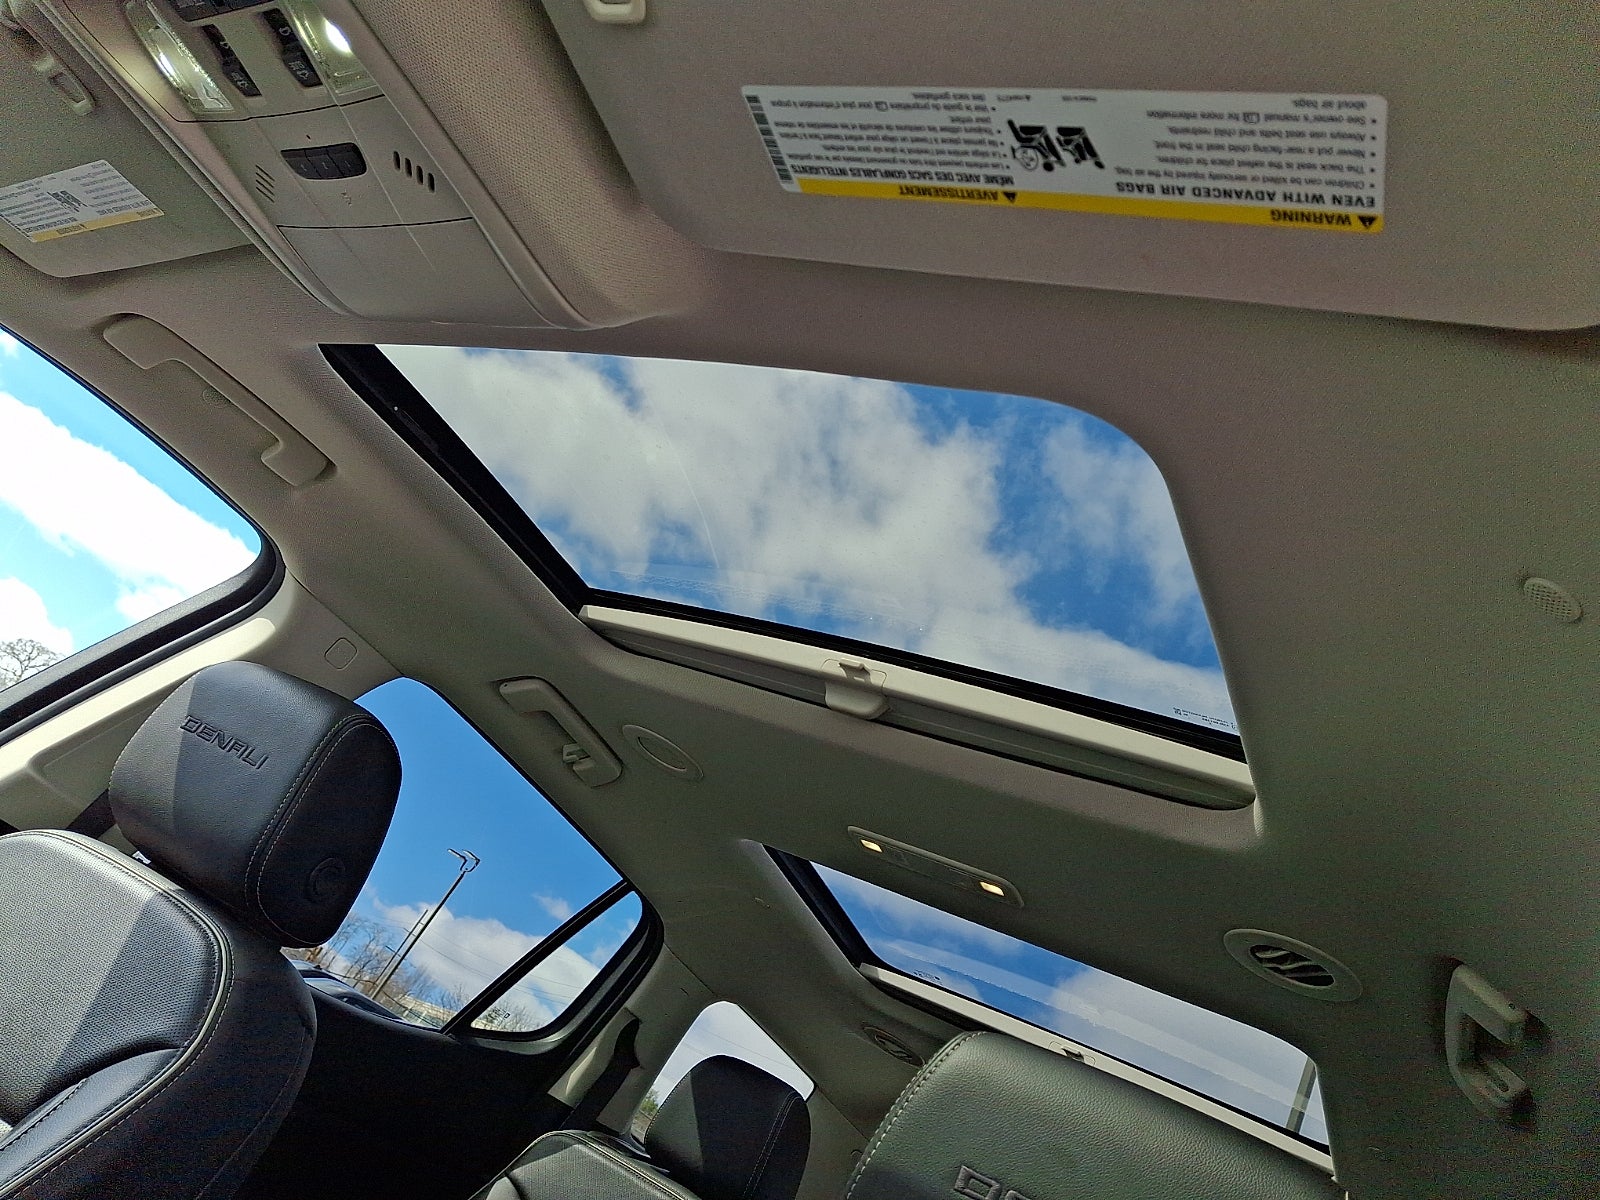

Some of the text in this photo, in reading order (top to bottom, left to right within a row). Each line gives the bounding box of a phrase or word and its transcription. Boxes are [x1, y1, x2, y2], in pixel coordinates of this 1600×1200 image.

[1321, 101, 1334, 109] air
[1338, 101, 1366, 110] about
[1200, 112, 1224, 120] more
[1228, 113, 1240, 121] for
[1264, 114, 1300, 122] manual
[1347, 116, 1366, 126] See
[1214, 129, 1236, 137] child
[1240, 129, 1256, 137] and
[1259, 130, 1283, 138] belts
[1330, 132, 1365, 141] Always
[1179, 142, 1193, 151] the
[1207, 143, 1225, 151] seat
[1318, 147, 1333, 156] put
[1337, 150, 1365, 158] Never
[1197, 158, 1208, 166] for
[1211, 158, 1234, 166] place
[1238, 160, 1265, 168] safest
[1320, 163, 1344, 172] back
[1347, 165, 1364, 174] The
[790, 164, 1014, 187] MÊME AVEC DES SACS GONFLABLES INTELLIGENTS
[1290, 177, 1302, 185] be
[1305, 177, 1322, 185] can
[1325, 179, 1364, 189] Children
[899, 185, 998, 201] AVERTISSEMENT
[1116, 182, 1375, 208] EVEN WITH ADVANCED AIR BAGS
[1271, 209, 1351, 226] WARNING
[180, 714, 269, 770] DENALI
